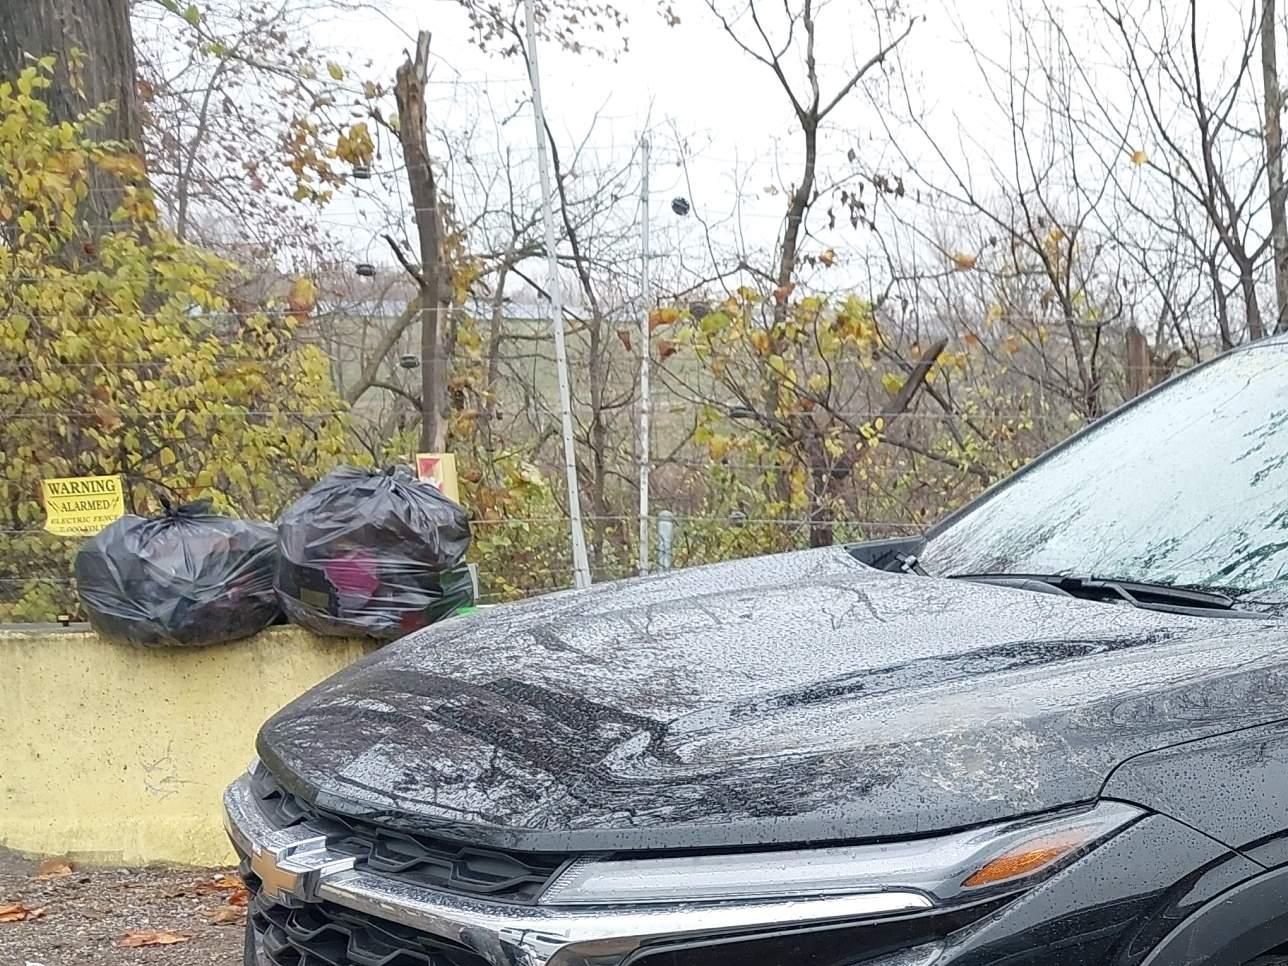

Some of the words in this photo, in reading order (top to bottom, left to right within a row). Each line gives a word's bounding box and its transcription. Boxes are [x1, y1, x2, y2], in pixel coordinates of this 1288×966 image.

[48, 480, 115, 495] WARNING
[60, 499, 111, 512] ALARMED
[51, 516, 91, 524] ELECTRIC
